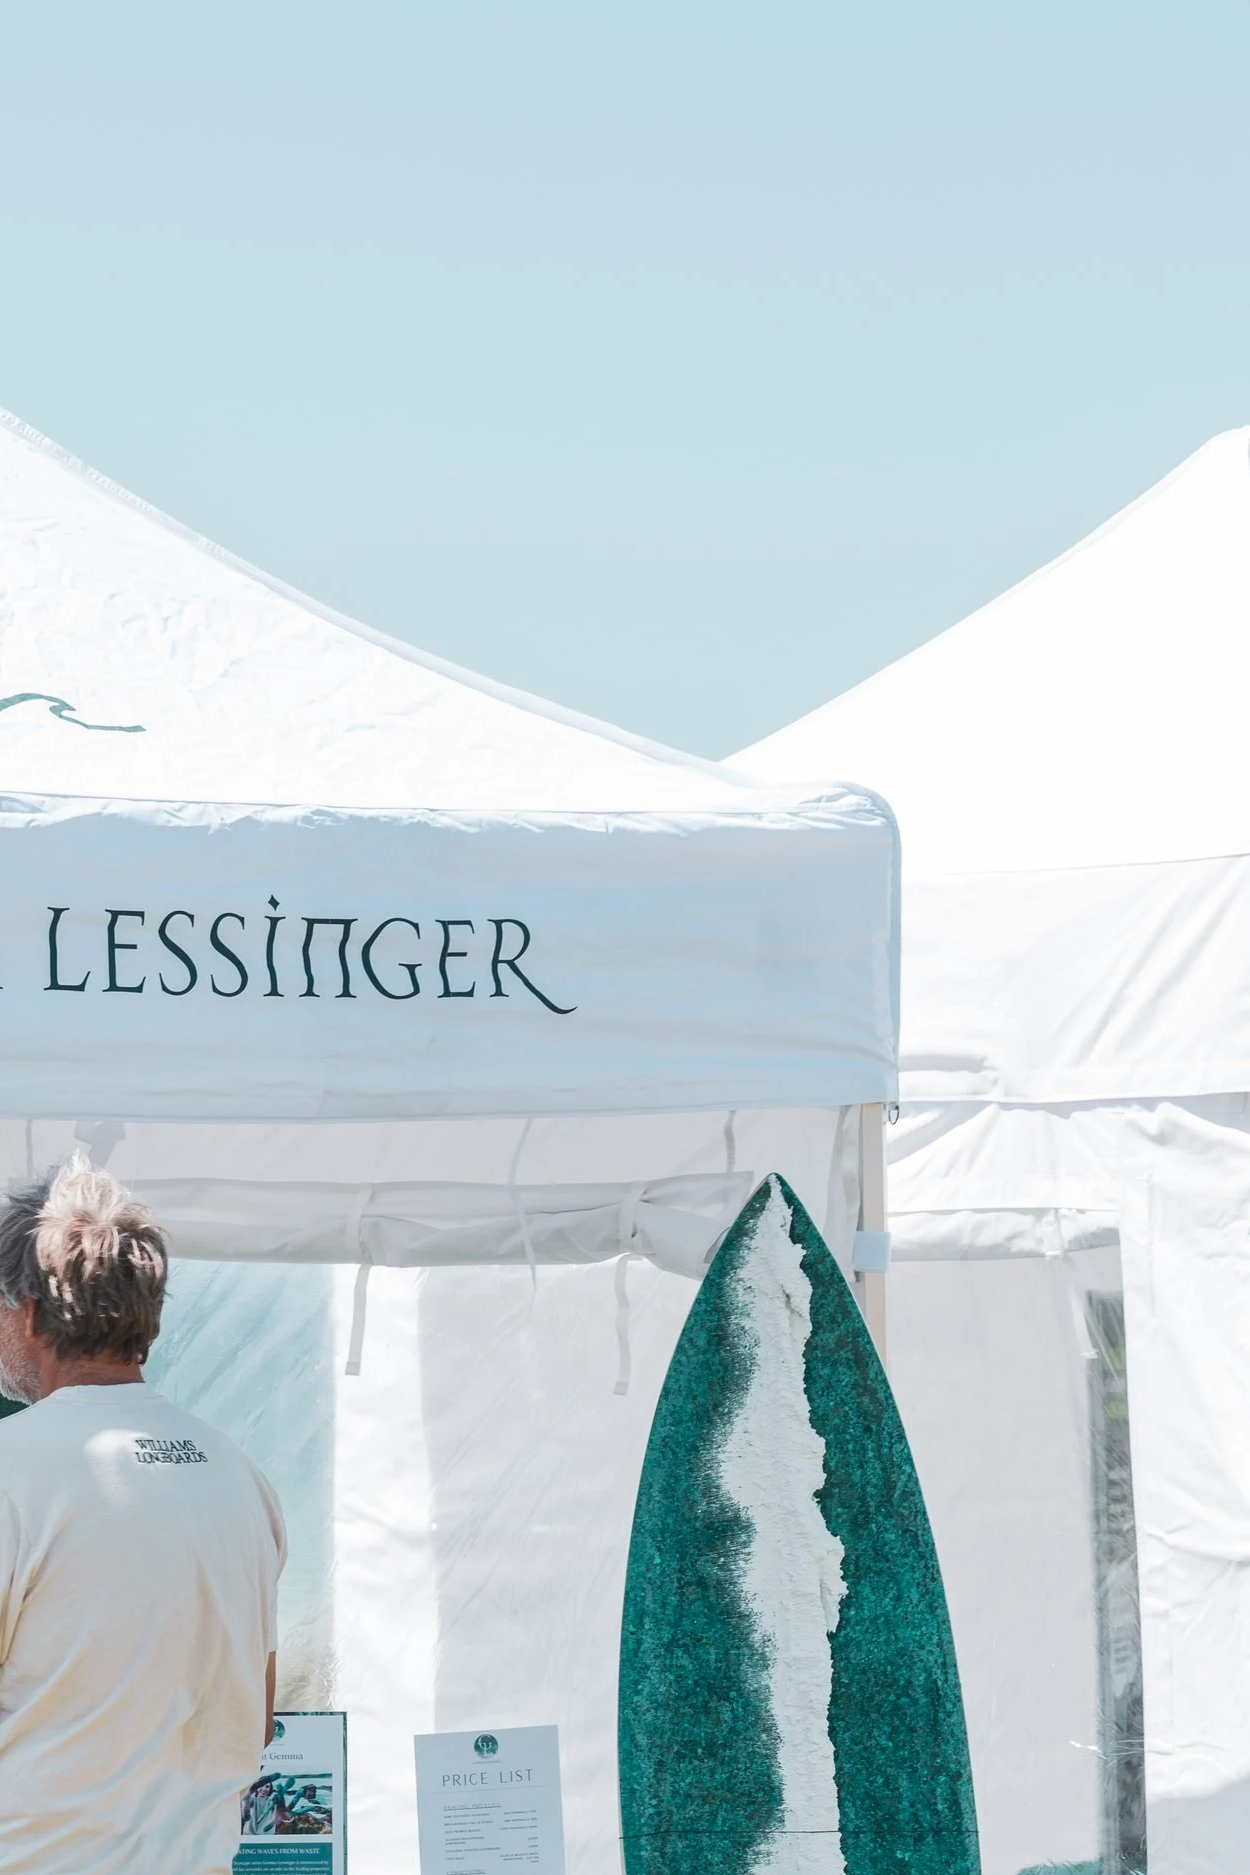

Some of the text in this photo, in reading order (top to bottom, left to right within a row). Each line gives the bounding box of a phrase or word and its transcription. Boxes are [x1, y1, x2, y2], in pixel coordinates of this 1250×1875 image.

[135, 1440, 197, 1452] WILLIAMS
[135, 1452, 208, 1464] LONGBOARDS
[270, 1752, 304, 1760] Gemma
[442, 1769, 533, 1787] PRICE LIST
